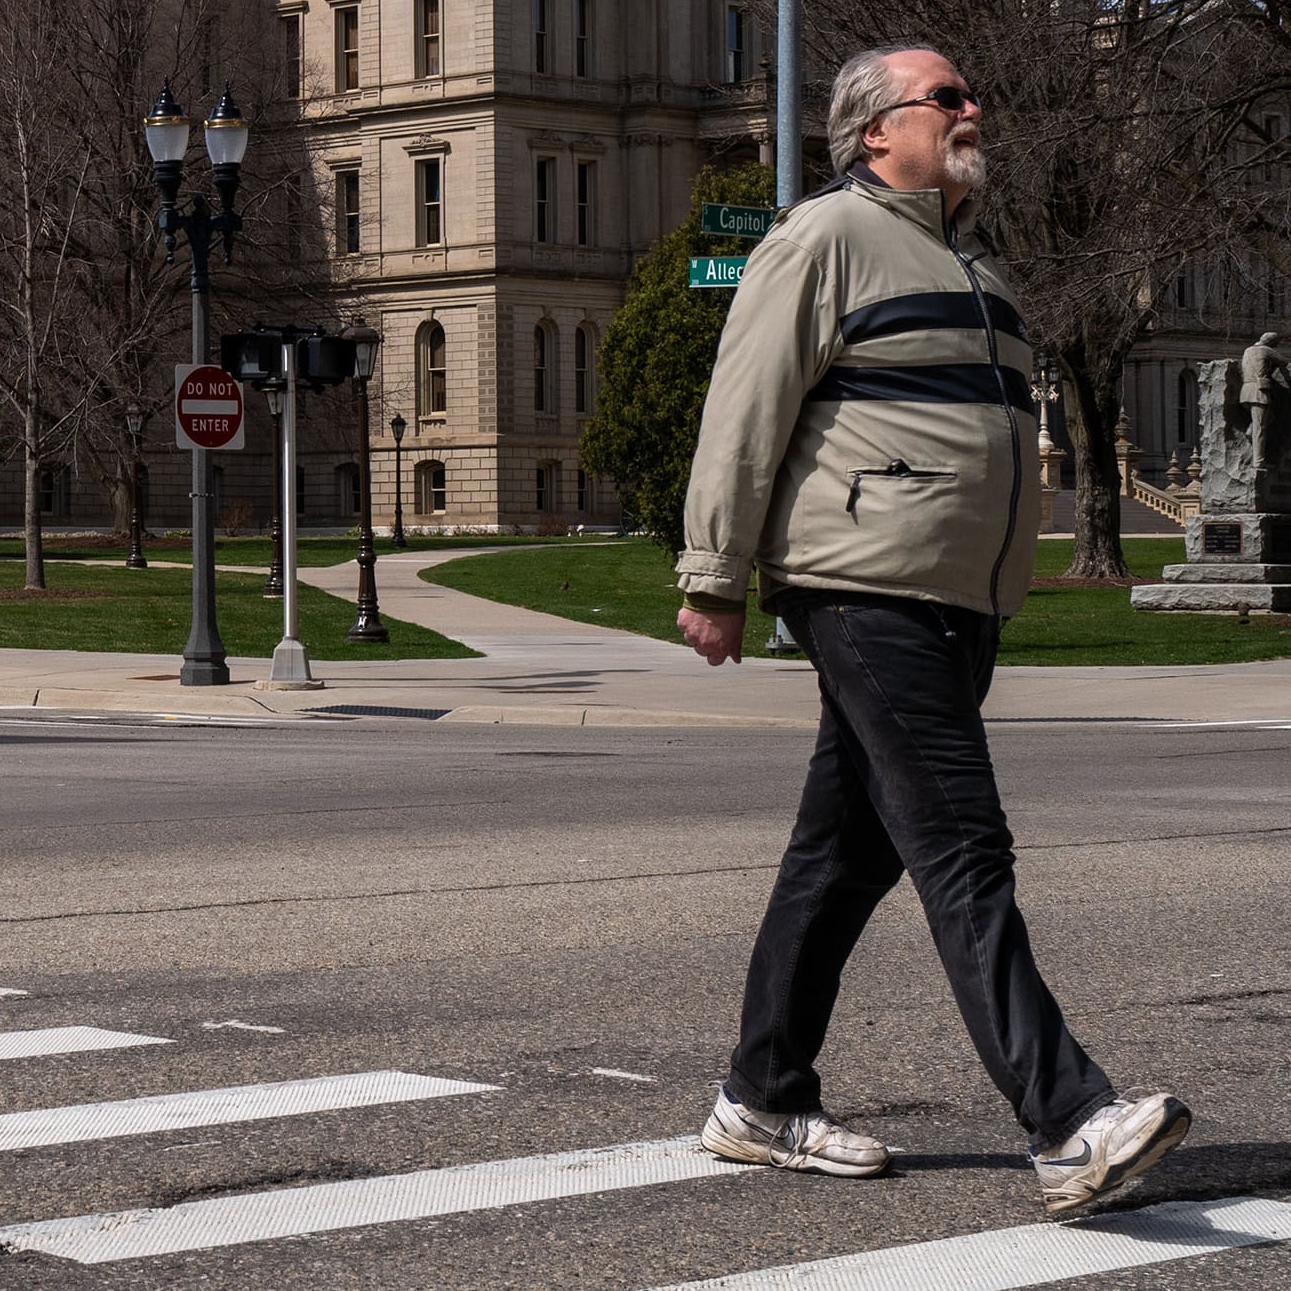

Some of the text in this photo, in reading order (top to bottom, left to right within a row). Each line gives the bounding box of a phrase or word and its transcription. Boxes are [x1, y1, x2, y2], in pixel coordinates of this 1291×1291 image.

[719, 207, 765, 234] Capitol
[691, 260, 698, 269] W
[187, 382, 233, 396] DO NOT
[192, 419, 229, 432] ENTER
